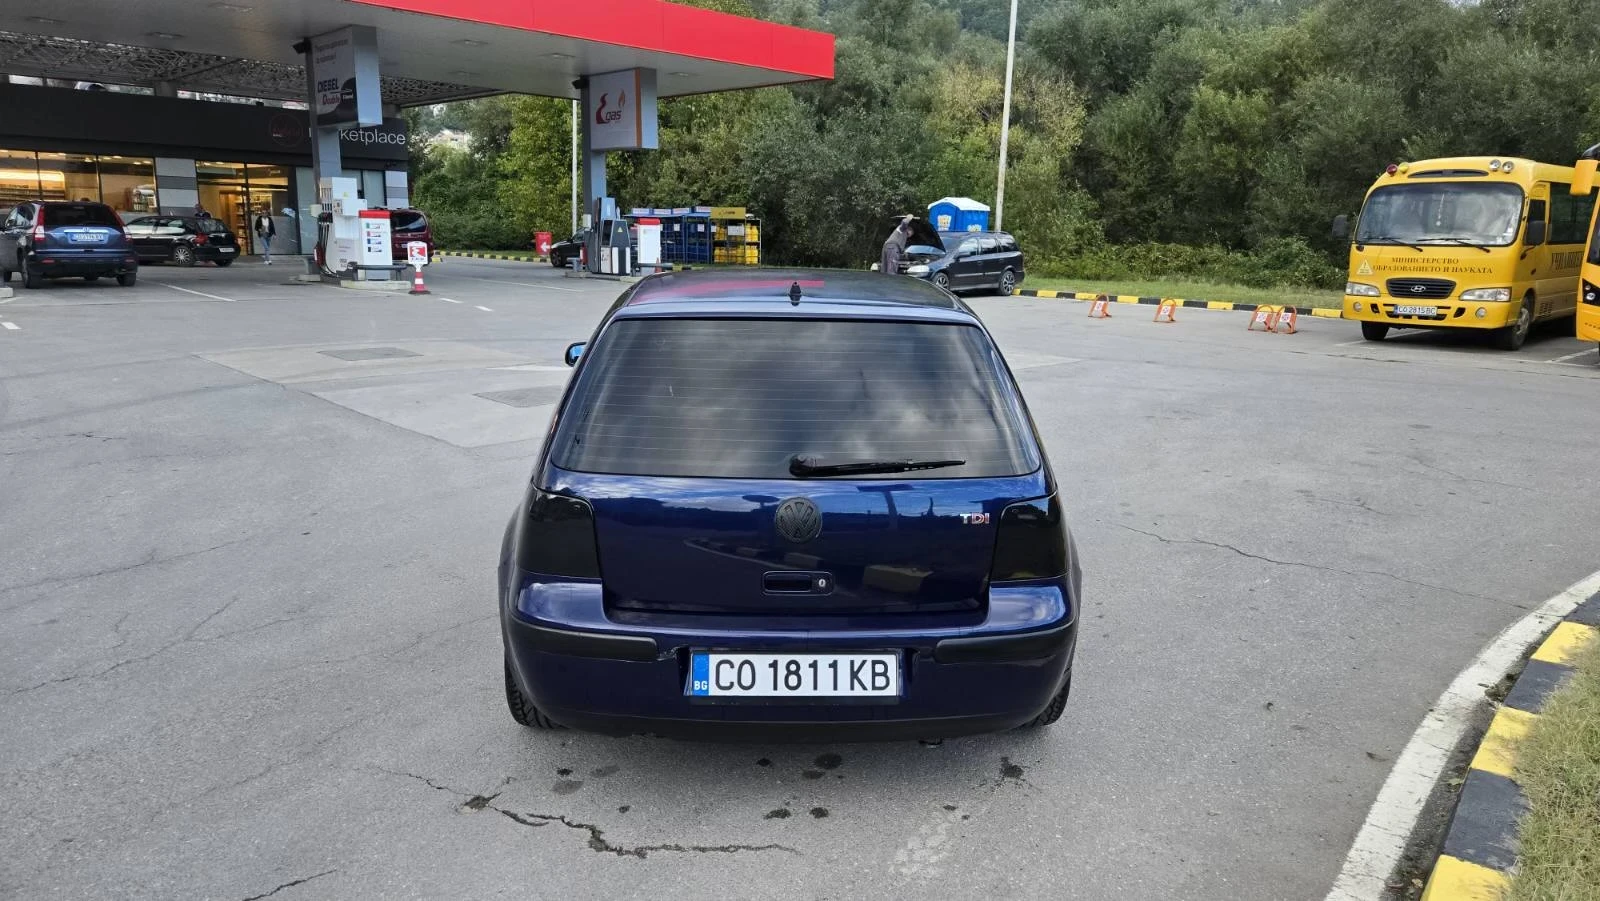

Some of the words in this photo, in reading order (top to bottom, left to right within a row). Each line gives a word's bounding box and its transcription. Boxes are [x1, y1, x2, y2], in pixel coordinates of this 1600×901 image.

[317, 78, 339, 93] DIESEL
[309, 127, 406, 146] ketplace
[1391, 257, 1460, 265] МИНИСТЕРСТВО
[1373, 264, 1441, 273] ОБРАЗОВАНИЕТО
[1442, 265, 1450, 273] И
[1451, 265, 1494, 274] НАУКАТА
[960, 512, 990, 524] TDI
[694, 681, 708, 691] BG
[715, 660, 756, 691] CO
[768, 660, 838, 691] 1811
[850, 660, 890, 691] KB
